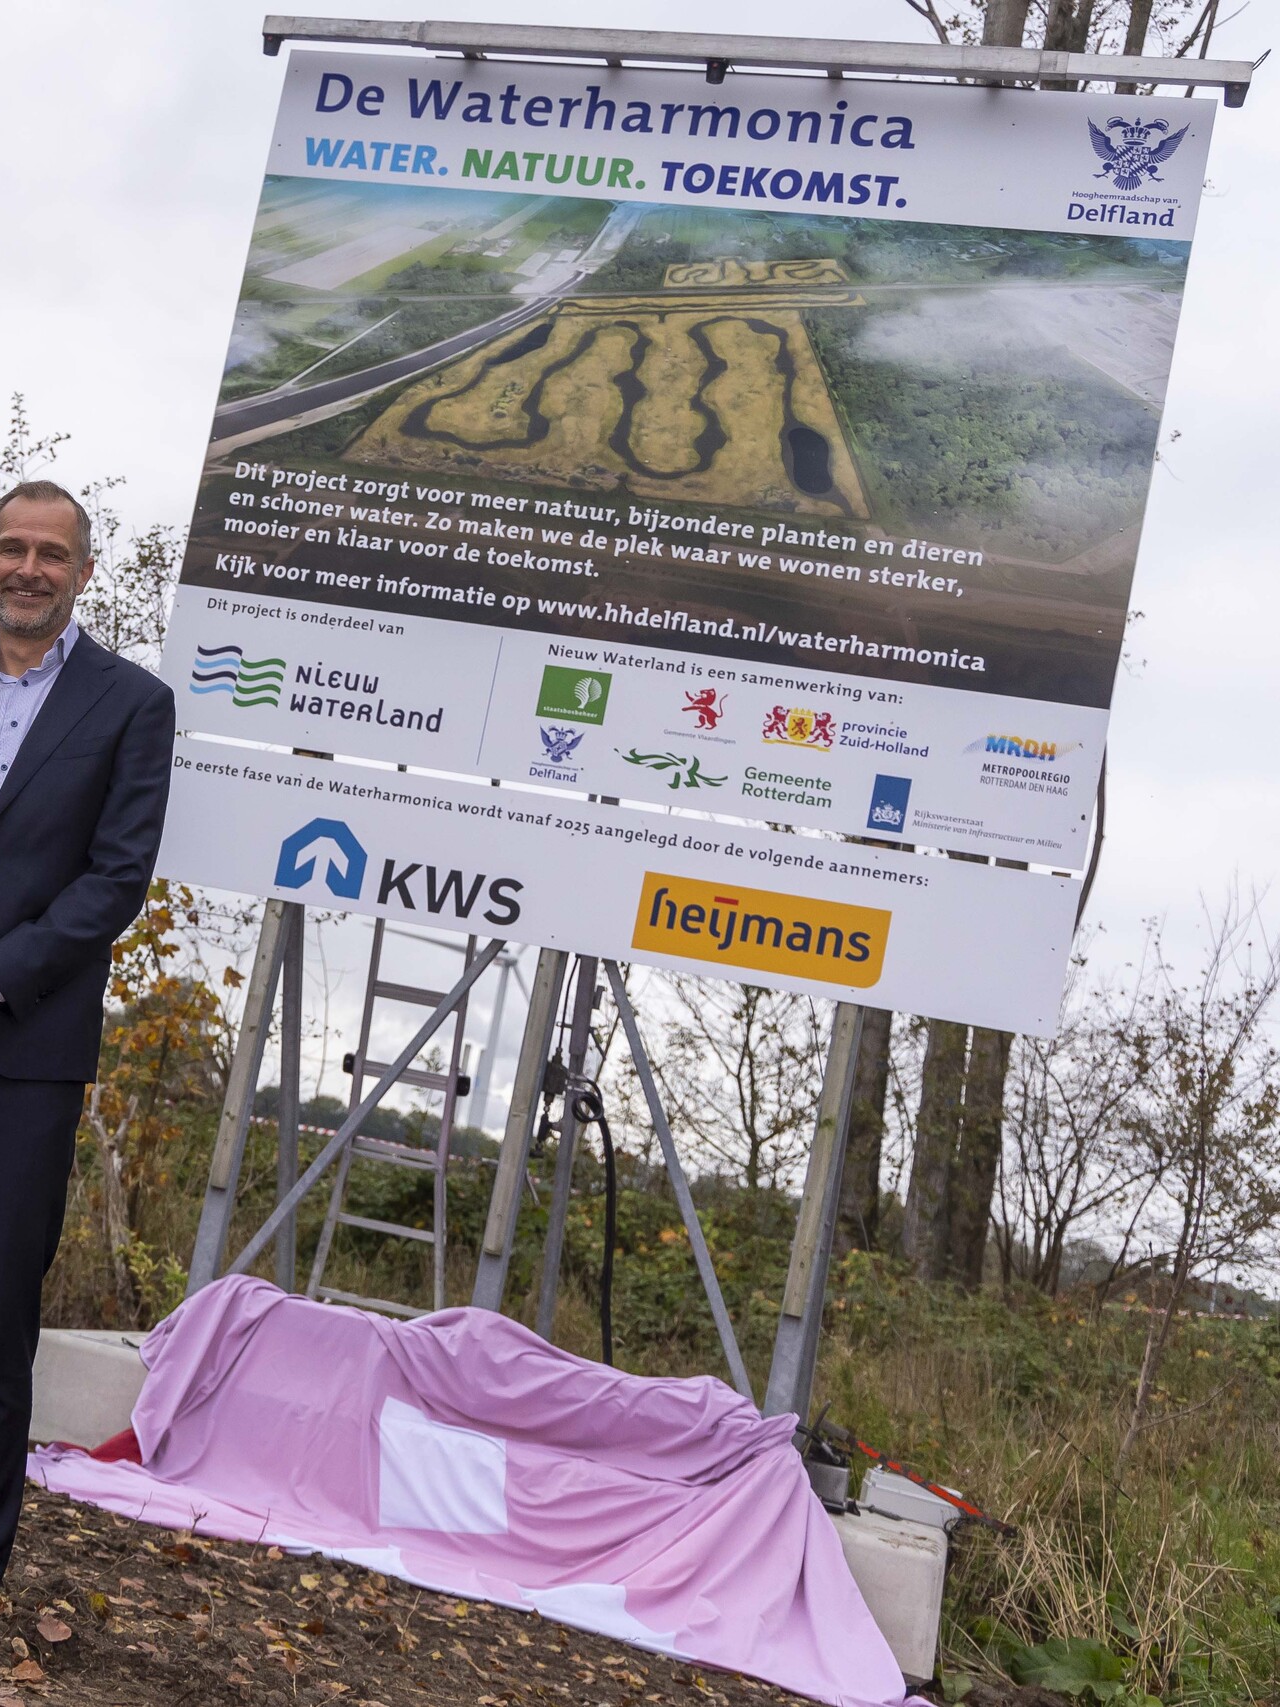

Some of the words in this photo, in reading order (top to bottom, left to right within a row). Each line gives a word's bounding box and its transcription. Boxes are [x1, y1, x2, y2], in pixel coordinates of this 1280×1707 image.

[315, 72, 385, 116] De
[408, 78, 915, 149] Waterharmonica
[305, 137, 448, 176] WATER.
[461, 149, 646, 190] NATUUR.
[661, 161, 907, 208] TOEKOMST.
[1072, 191, 1160, 204] Hoogheemraadschap
[1067, 203, 1175, 227] Delfland
[234, 461, 266, 481] Dit
[271, 469, 347, 493] project
[353, 479, 410, 503] zorgt
[416, 486, 465, 504] voor
[471, 493, 528, 513] meer
[534, 499, 620, 527] natuur,
[629, 507, 755, 539] bijzondere
[761, 524, 857, 551] planten
[864, 540, 894, 556] en
[902, 540, 983, 566] dieren
[224, 516, 299, 540] mooier
[305, 529, 330, 545] en
[337, 527, 393, 553] klaar
[399, 540, 448, 558] voor
[454, 543, 480, 563] de
[486, 547, 599, 577] toekomst.
[229, 491, 254, 507] en
[260, 494, 344, 518] schoner
[350, 505, 418, 527] water.
[425, 511, 451, 531] Zo
[458, 517, 533, 541] maken
[541, 530, 573, 545] we
[579, 529, 607, 549] de
[614, 535, 664, 557] plek
[671, 544, 731, 565] waar
[737, 553, 771, 569] we
[779, 558, 860, 581] wonen
[869, 567, 963, 597] sterker,
[207, 598, 227, 611] Dit
[231, 602, 281, 619] project
[286, 609, 296, 621] is
[301, 612, 374, 631] onderdeel
[378, 623, 405, 635] van
[215, 553, 255, 578] Kijk
[262, 563, 310, 581] voor
[315, 570, 371, 590] meer
[376, 573, 495, 606] informatie
[502, 595, 531, 615] op
[538, 598, 985, 671] www.hhdelfland.nl/waterharmonica
[548, 644, 598, 661] Nieuw
[603, 651, 686, 674] Waterland
[691, 663, 702, 676] is
[708, 668, 736, 681] een
[741, 673, 862, 702] samenwerking
[868, 690, 903, 704] van:
[842, 722, 908, 739] provincie
[839, 735, 929, 757] Zuid-Holland
[985, 734, 1057, 761] MRDH
[529, 767, 577, 782] Delfland
[745, 766, 832, 791] Gemeente
[980, 775, 1027, 790] ROTTERDAM
[1029, 782, 1044, 792] DEN
[1046, 785, 1069, 796] HAAG
[982, 763, 1070, 784] METROPOOLREGIO
[741, 782, 832, 808] Rotterdam
[173, 756, 191, 770] De
[195, 761, 239, 777] eerste
[243, 766, 271, 782] fase
[276, 775, 302, 788] van
[306, 776, 324, 791] de
[328, 780, 453, 812] Waterharmonica
[458, 803, 503, 819] wordt
[507, 811, 551, 827] vanaf
[556, 818, 590, 835] 2025
[594, 823, 678, 848] aangelegd
[683, 835, 720, 853] door
[724, 841, 744, 857] de
[749, 848, 824, 871] volgende
[829, 860, 929, 887] aannemers:
[914, 809, 984, 827] Rijkswaterstaat
[912, 819, 951, 832] Ministerie
[969, 827, 1023, 843] Infrastructuur
[1037, 839, 1062, 849] Milieu
[376, 858, 525, 926] KWS
[649, 887, 872, 963] heijmans
